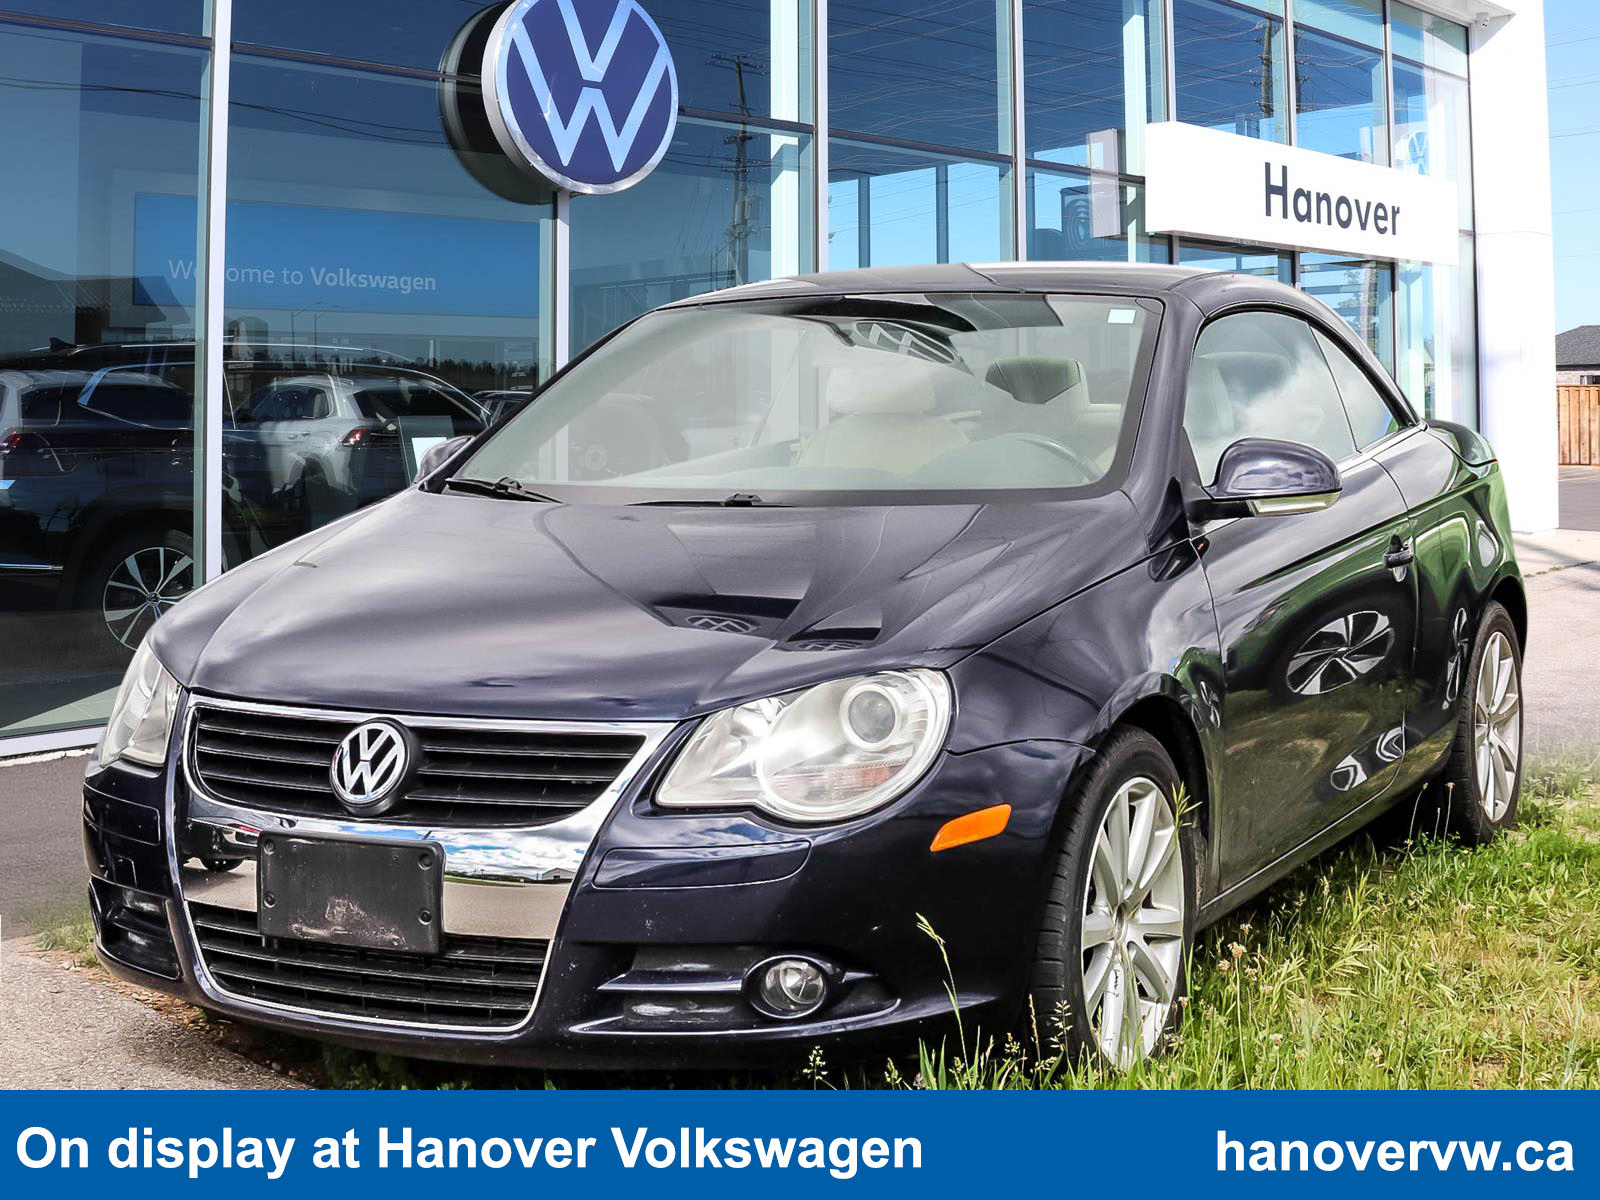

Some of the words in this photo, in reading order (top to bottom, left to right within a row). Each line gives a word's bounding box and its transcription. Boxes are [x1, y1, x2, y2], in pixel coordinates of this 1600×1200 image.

[504, 0, 670, 174] VW
[1264, 161, 1400, 236] Hanover
[168, 258, 274, 284] Wome
[281, 267, 304, 285] to
[310, 266, 436, 294] Volkswagen
[339, 727, 399, 797] VW
